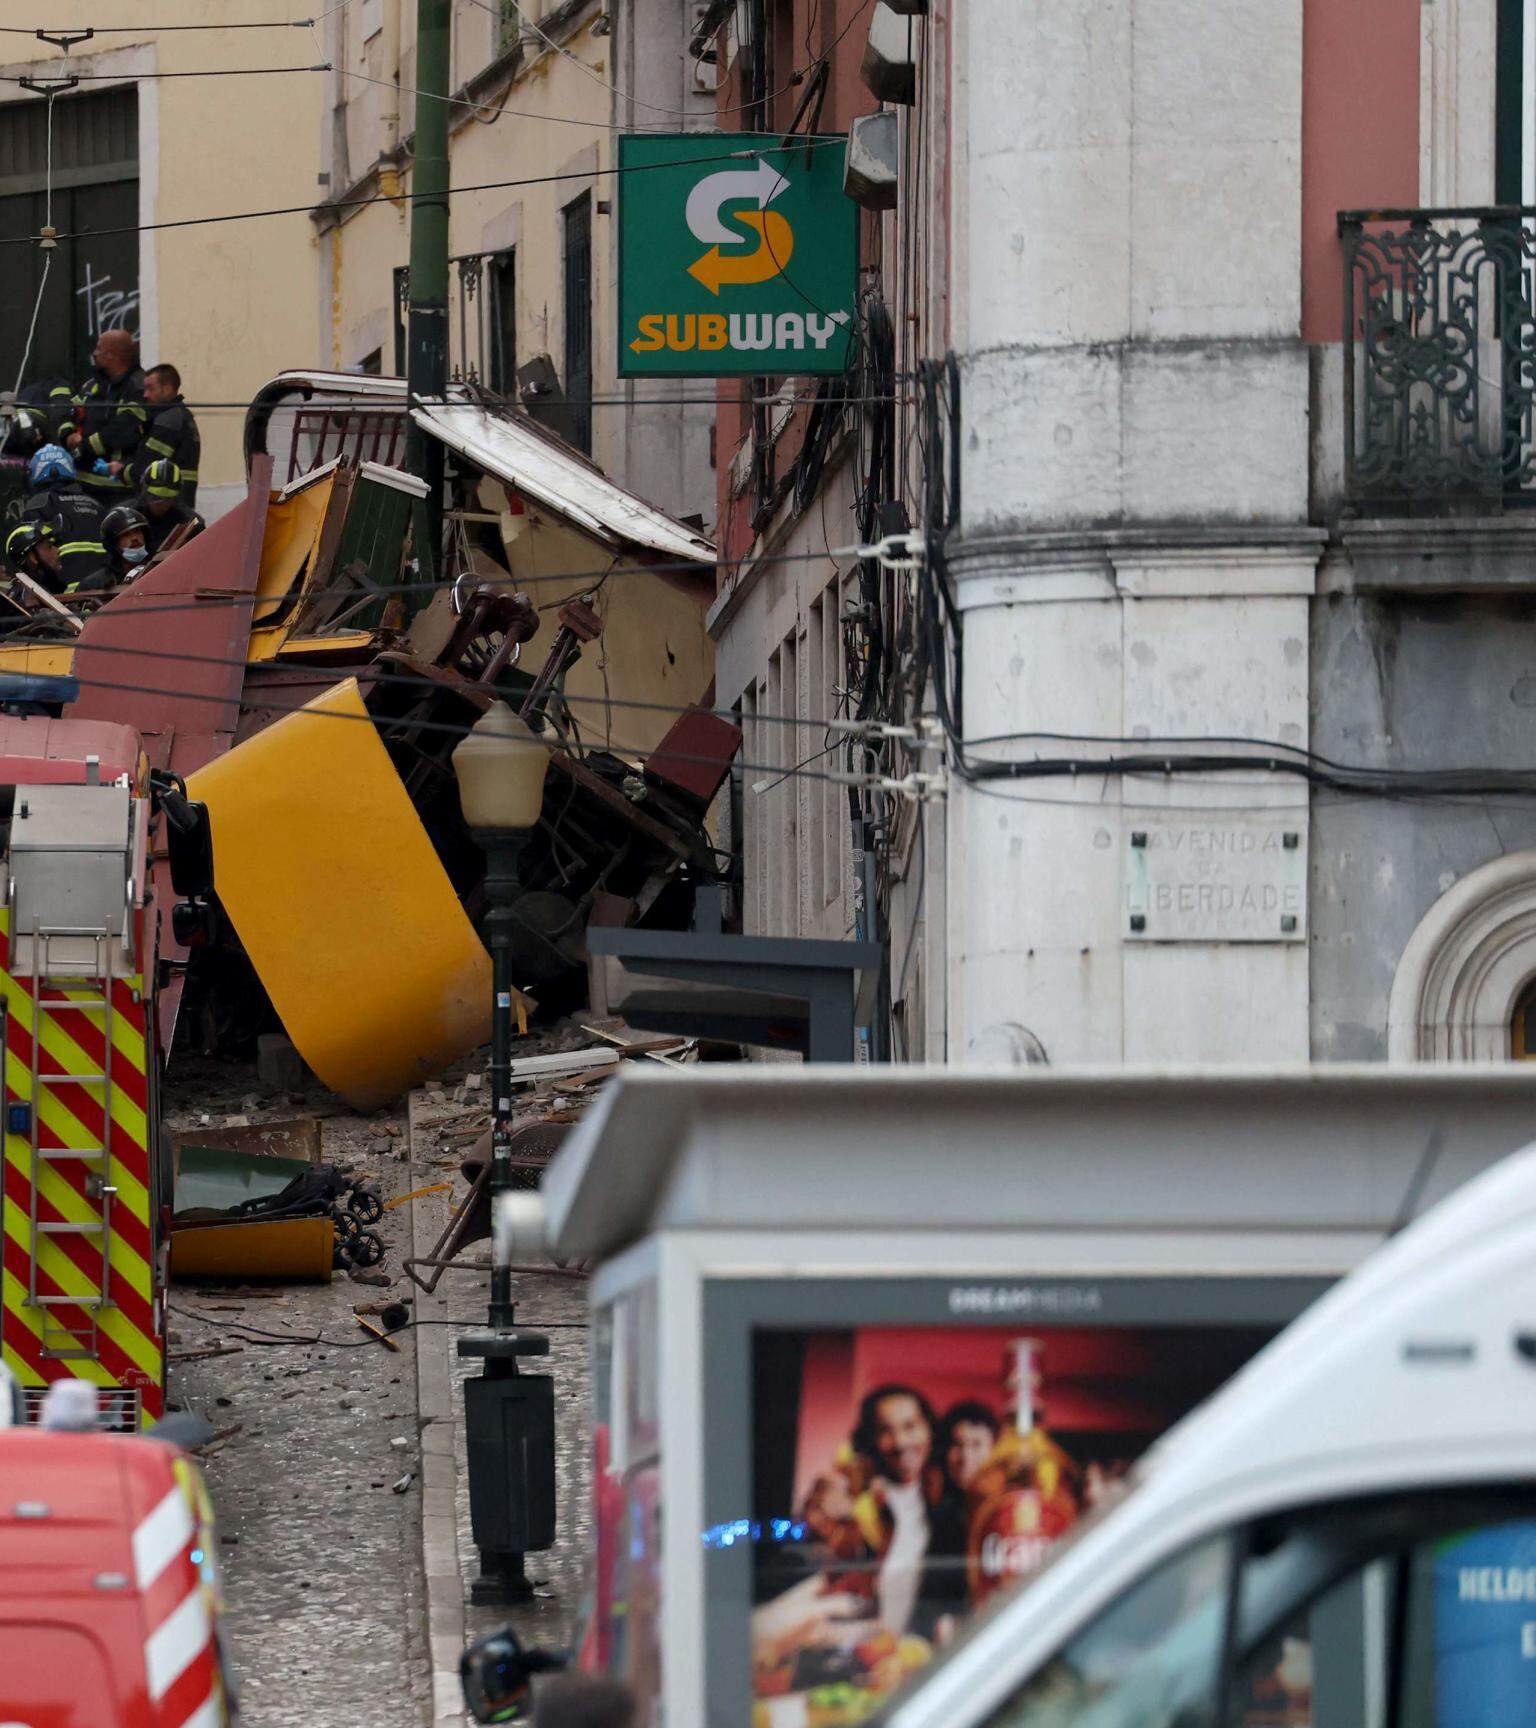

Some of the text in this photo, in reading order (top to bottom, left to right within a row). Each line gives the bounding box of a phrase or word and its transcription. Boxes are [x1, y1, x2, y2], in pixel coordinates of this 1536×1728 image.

[629, 311, 851, 354] SUBWAY
[1149, 831, 1282, 852] AVENIDA
[1127, 884, 1300, 913] LIBERDADE
